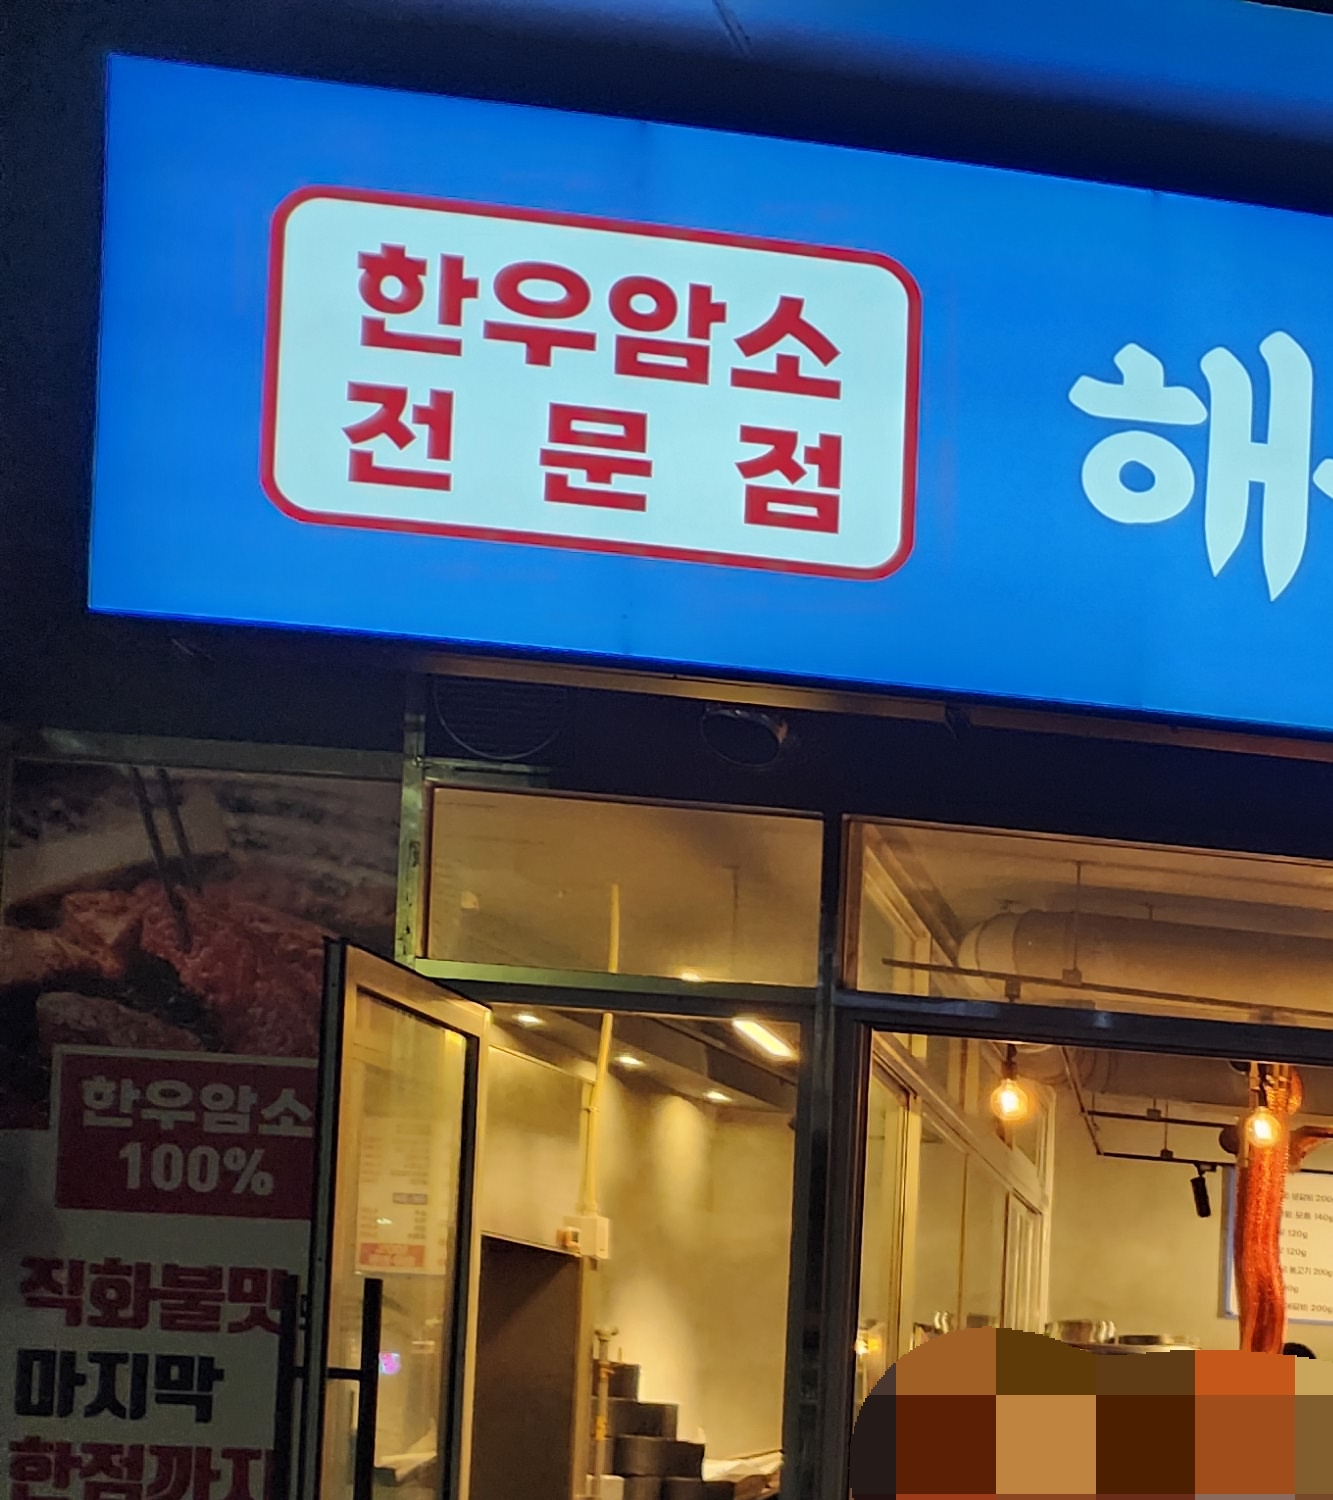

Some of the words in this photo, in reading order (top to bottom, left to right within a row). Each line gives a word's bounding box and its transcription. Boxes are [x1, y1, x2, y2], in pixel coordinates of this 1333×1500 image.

[357, 243, 842, 400] 한우암소
[80, 1074, 314, 1137] 한우암소
[119, 1142, 274, 1195] 100%
[19, 1257, 309, 1334] 직화불맛
[14, 1349, 224, 1423] 마지막
